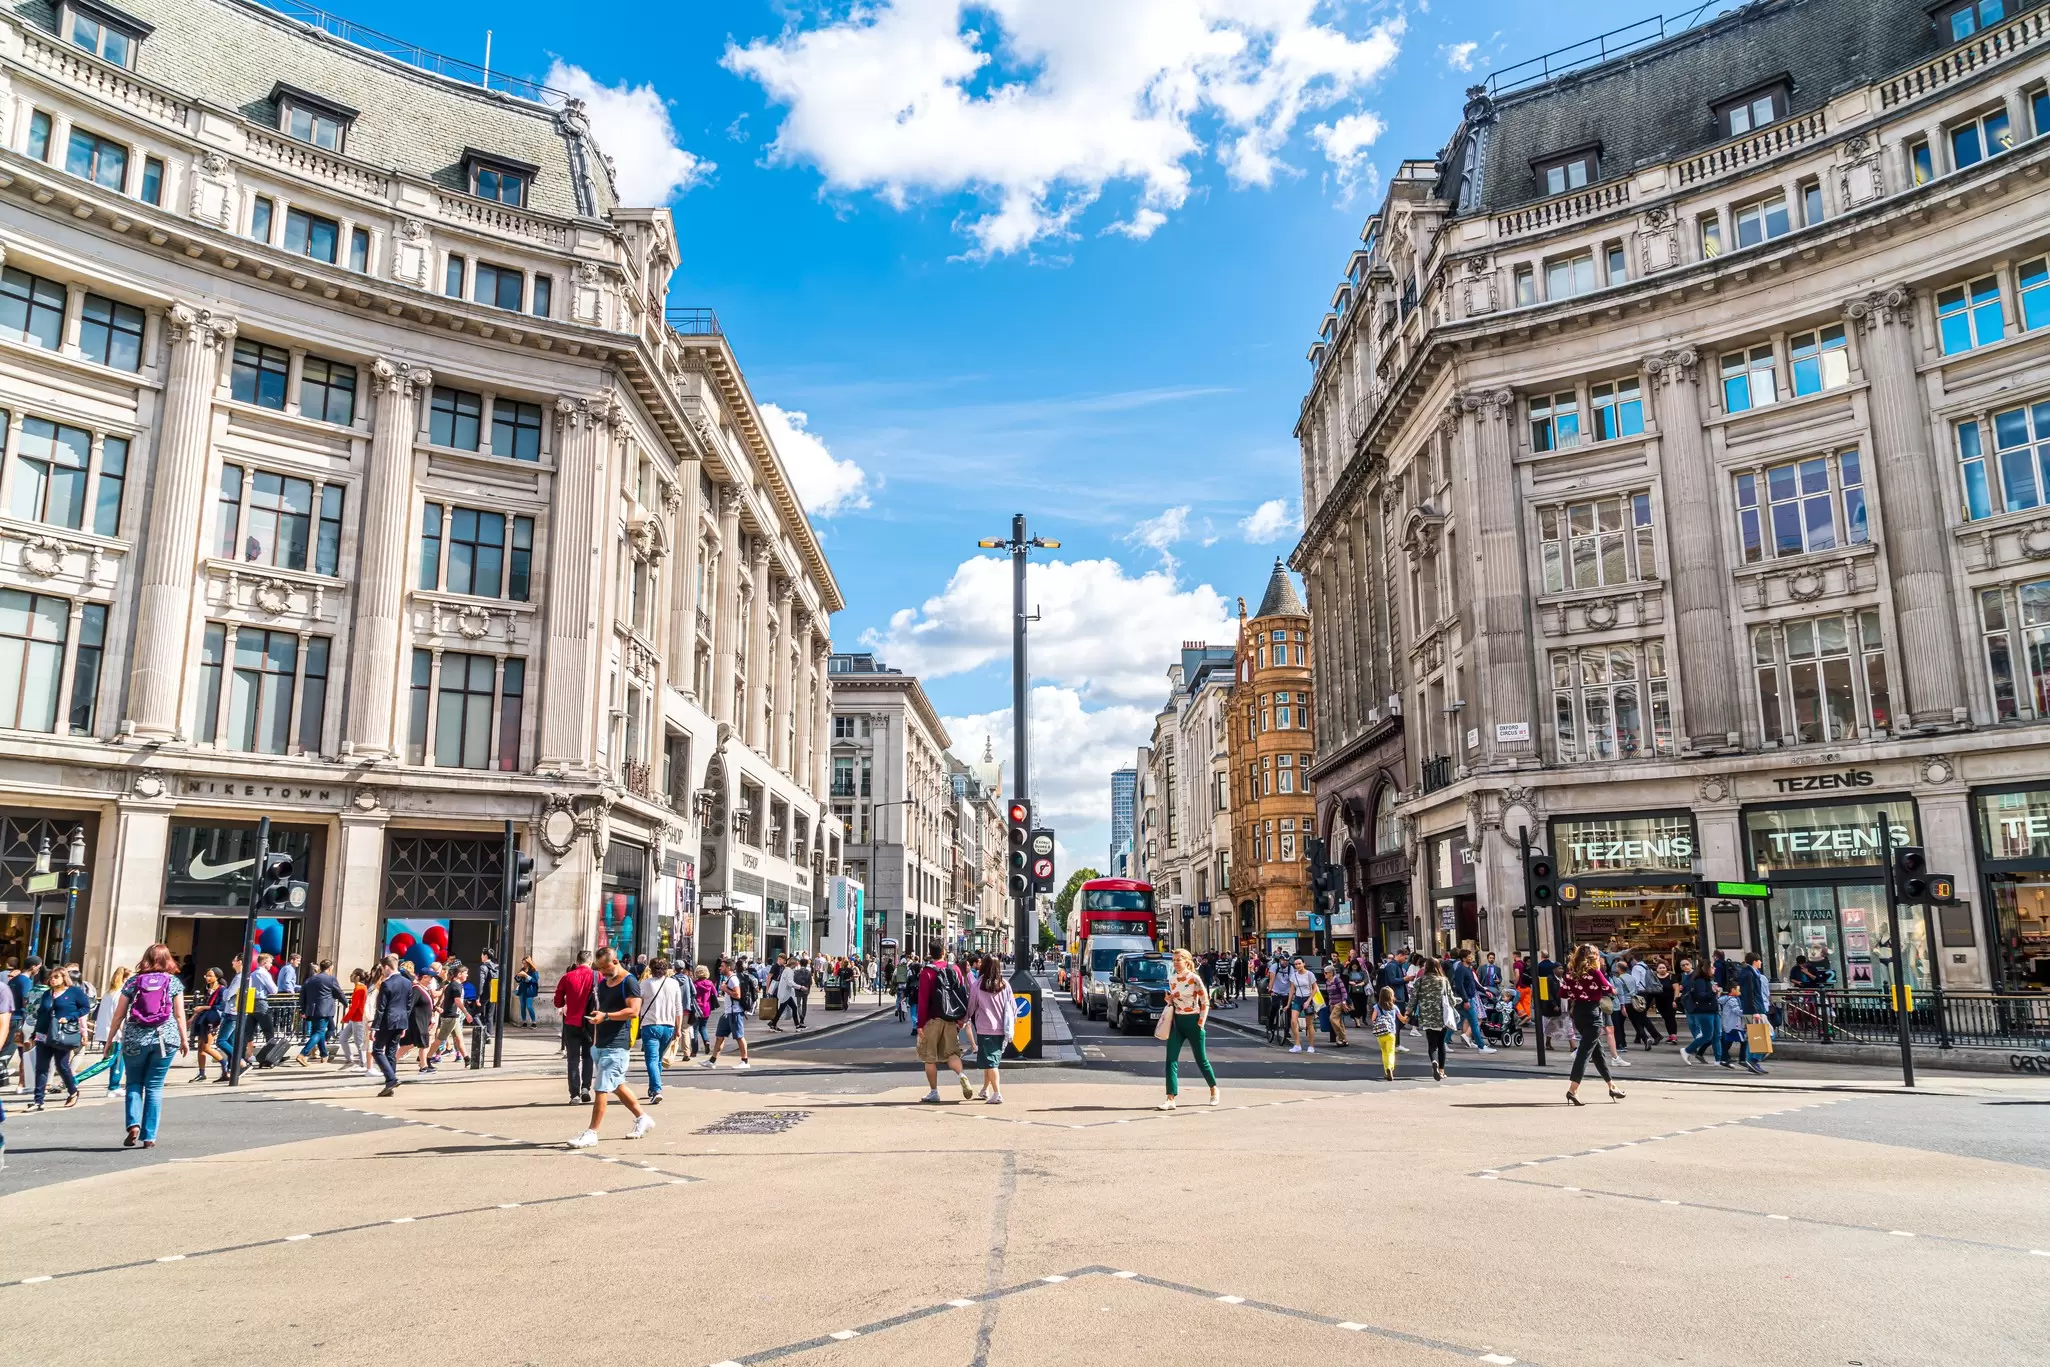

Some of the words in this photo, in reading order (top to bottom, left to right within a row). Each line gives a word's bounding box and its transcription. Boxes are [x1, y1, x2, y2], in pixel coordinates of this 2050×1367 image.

[1773, 769, 1874, 793] TEZENIS
[189, 782, 330, 800] NIKETOWN
[1568, 834, 1692, 861] TEZENIS
[1793, 910, 1832, 919] HAVANA
[1131, 922, 1144, 932] 73
